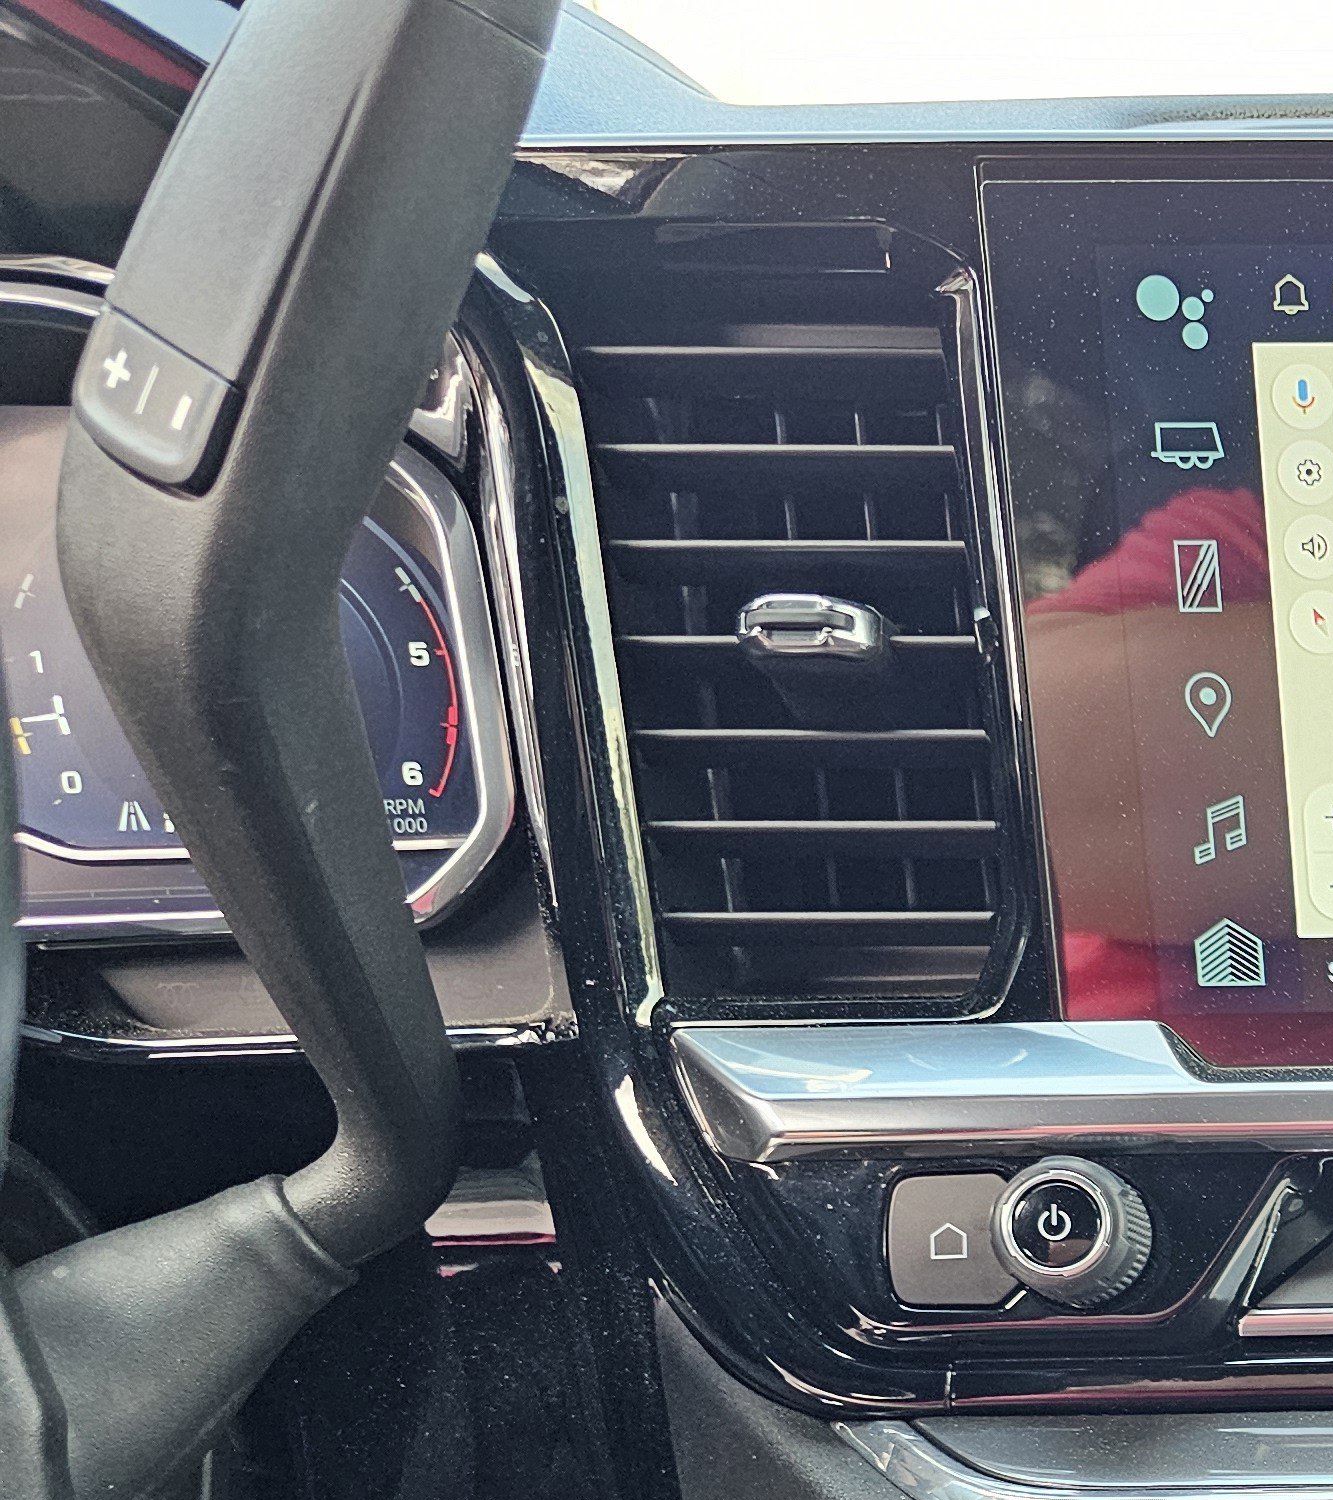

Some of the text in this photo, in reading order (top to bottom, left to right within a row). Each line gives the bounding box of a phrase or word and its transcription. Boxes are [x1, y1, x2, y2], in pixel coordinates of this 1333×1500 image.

[29, 650, 44, 674] 1
[409, 641, 430, 667] 5
[60, 770, 83, 794] 0
[401, 761, 424, 786] 6
[383, 798, 426, 815] RPM
